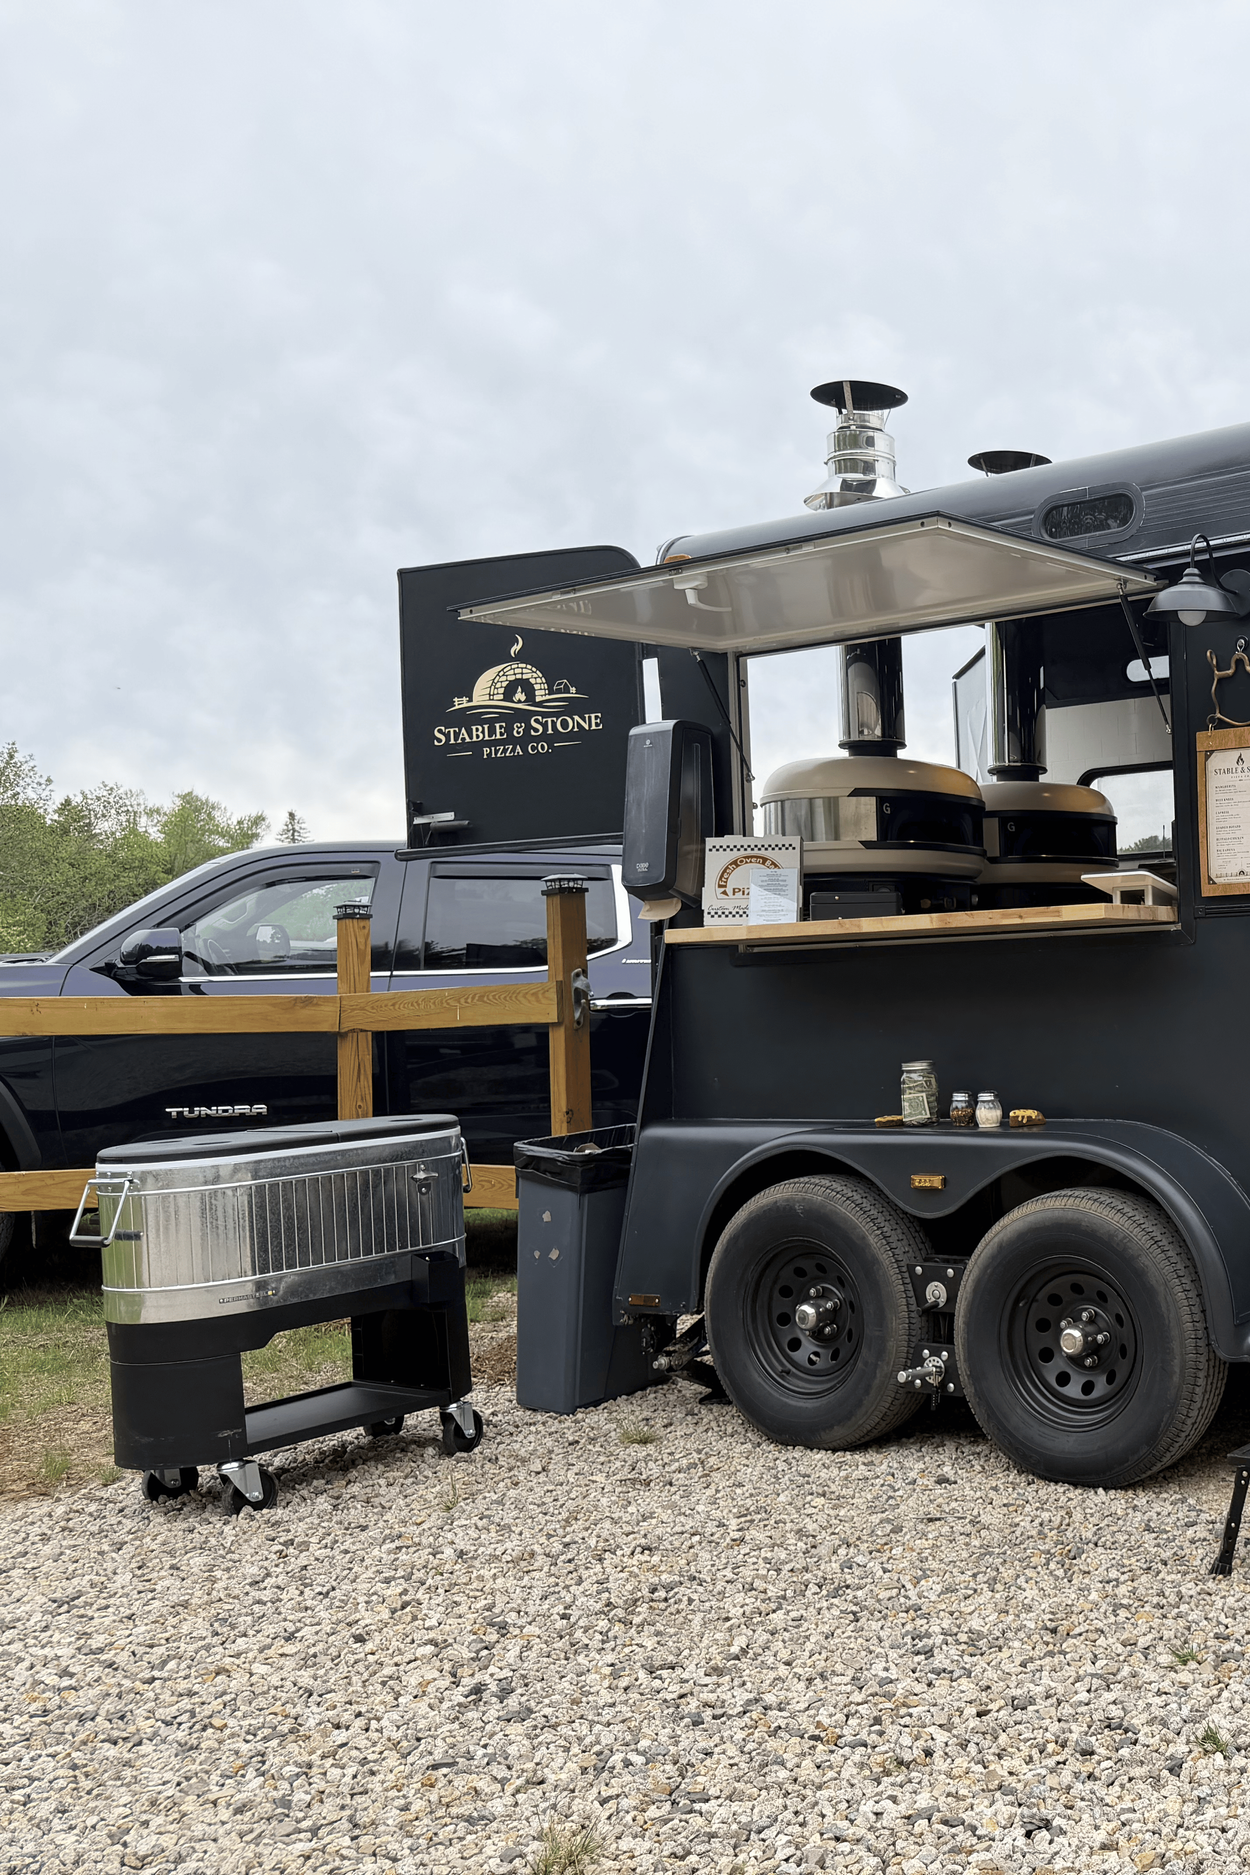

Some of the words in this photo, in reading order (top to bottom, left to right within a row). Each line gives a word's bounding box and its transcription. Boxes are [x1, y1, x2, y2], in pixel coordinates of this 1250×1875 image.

[433, 722, 507, 746] STABLE
[513, 722, 525, 737] &
[530, 713, 603, 736] STONE
[482, 745, 523, 759] PIZZA
[528, 742, 552, 754] CO.
[1214, 767, 1239, 775] STABLE
[883, 803, 891, 814] G
[1007, 822, 1016, 832] G
[719, 864, 736, 885] Fresh
[737, 857, 763, 865] Oven
[165, 1104, 268, 1119] TUNDRA
